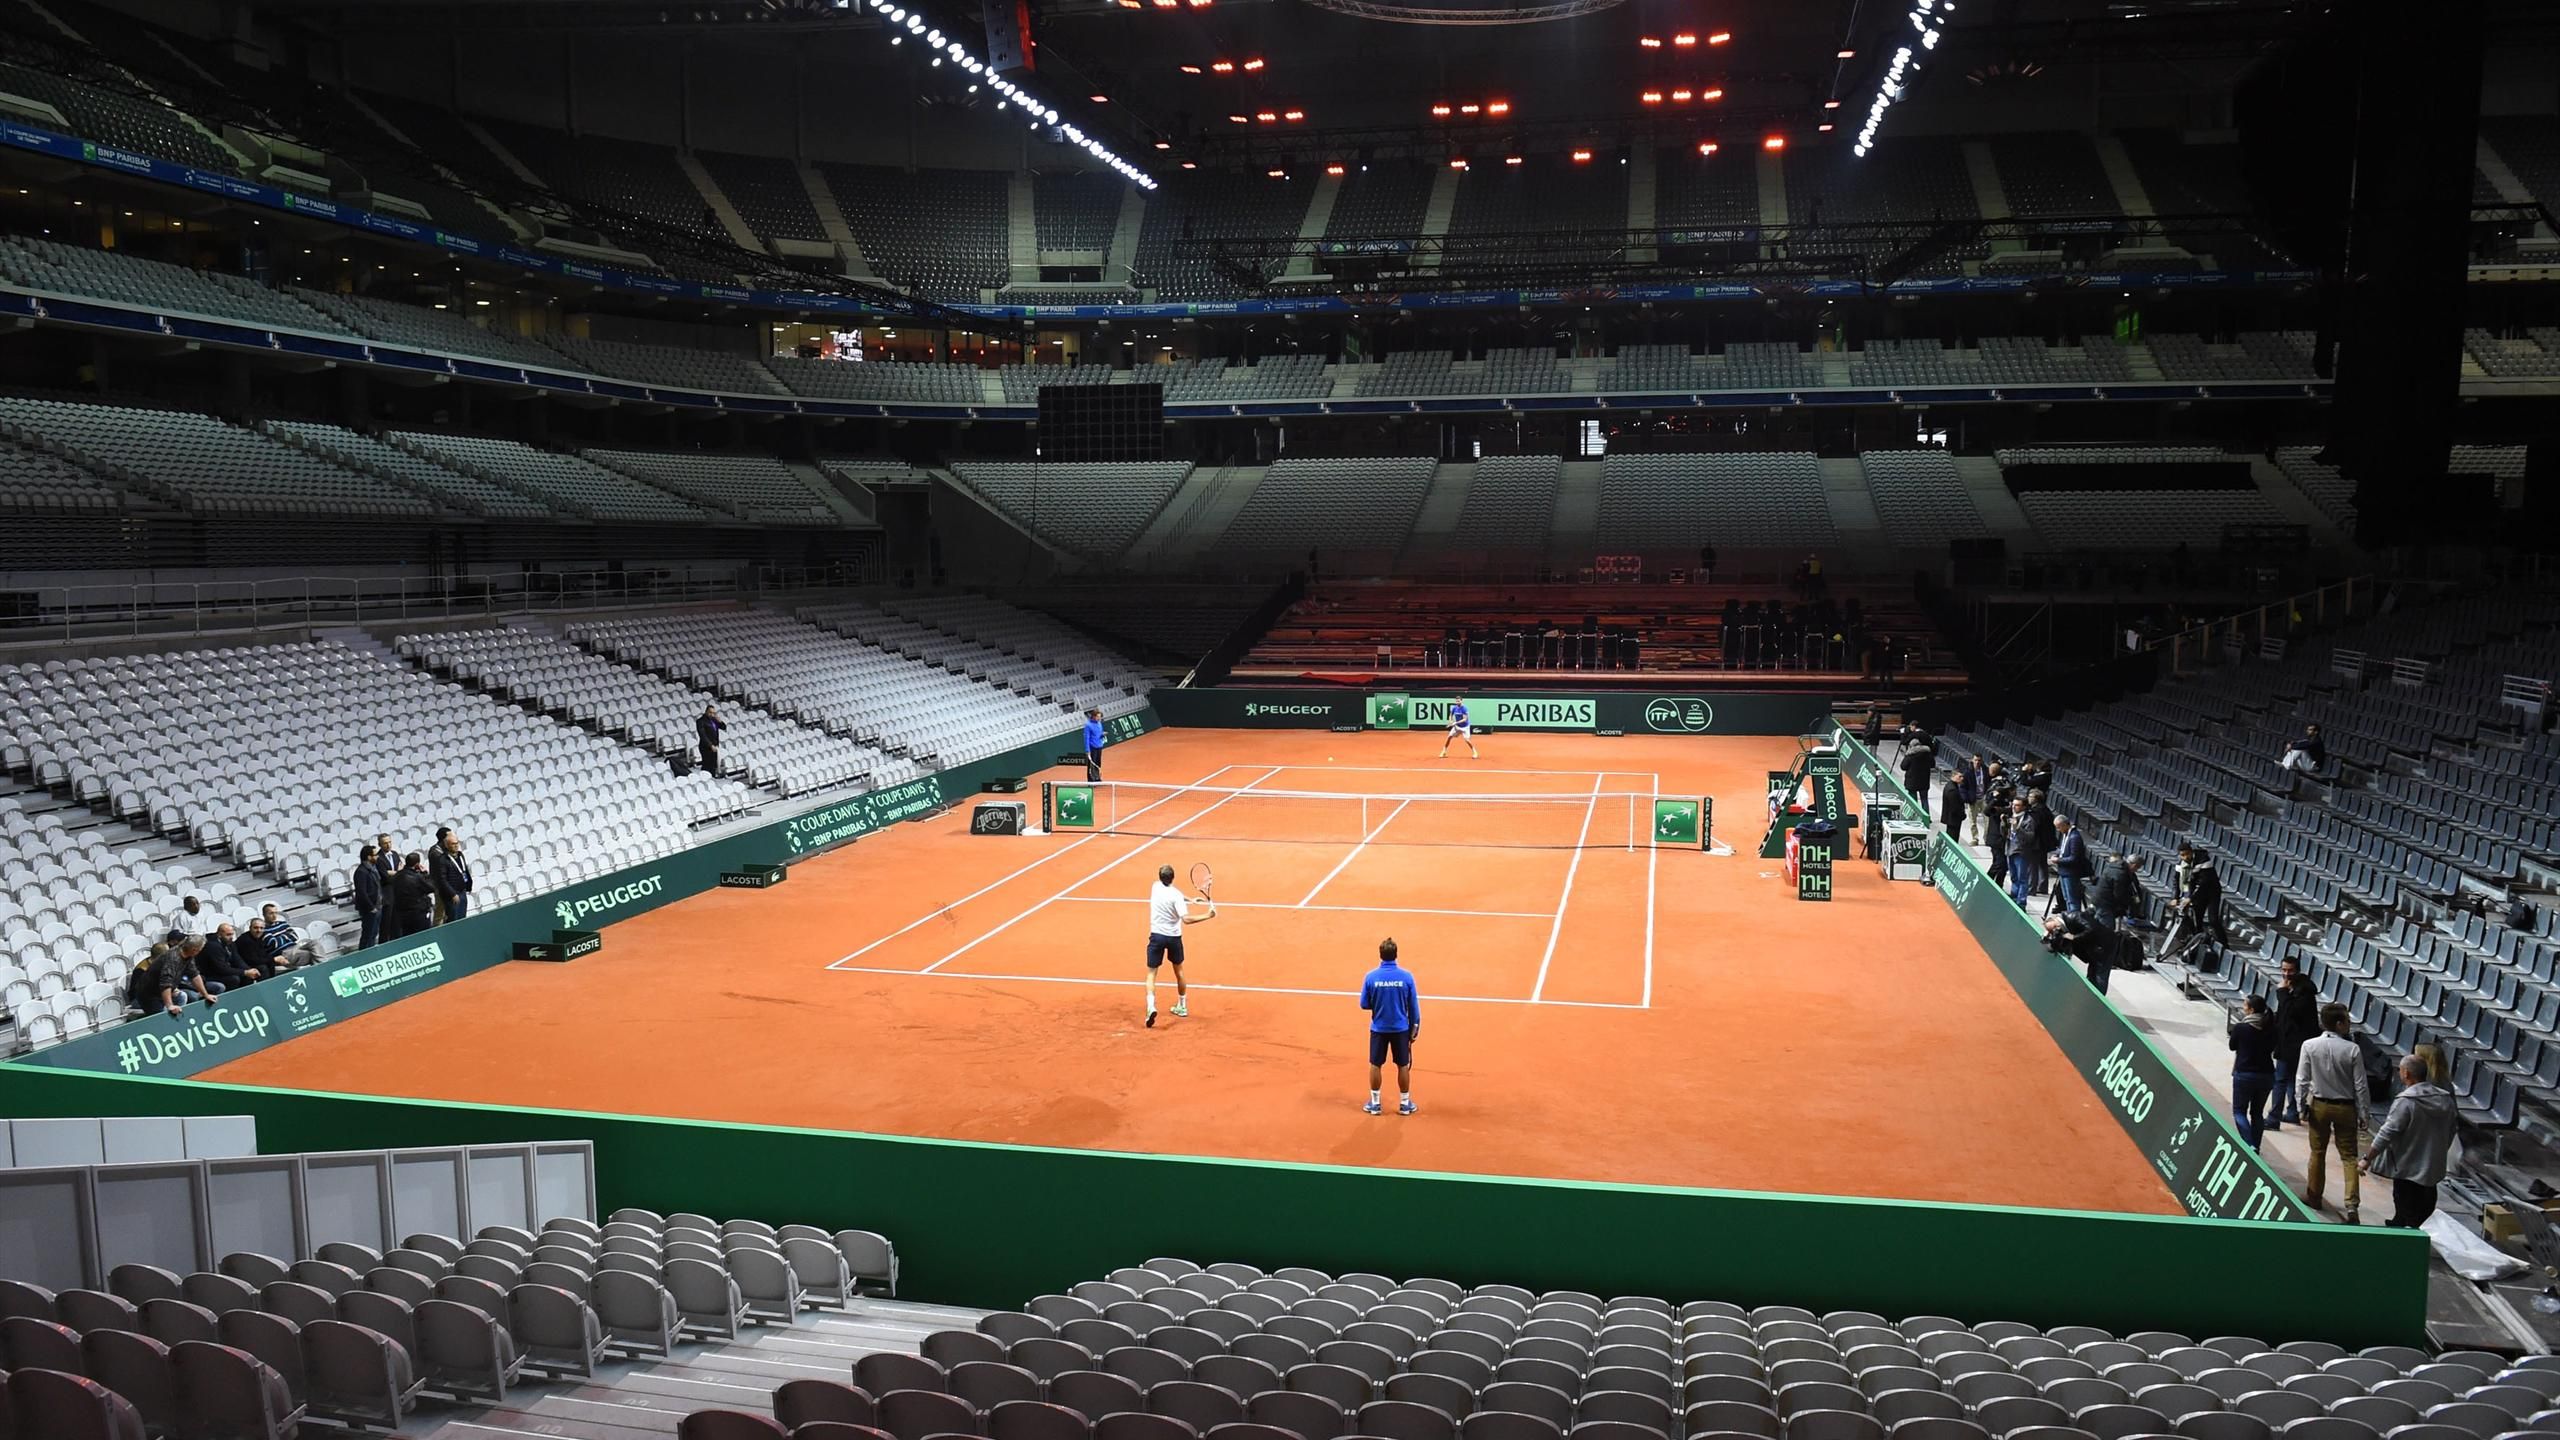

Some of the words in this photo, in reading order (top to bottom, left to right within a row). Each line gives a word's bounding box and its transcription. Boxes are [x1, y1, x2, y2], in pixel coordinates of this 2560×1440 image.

[98, 148, 115, 159] BNP
[116, 151, 151, 167] PARIBAS
[1260, 705, 1332, 714] PEUGEOT
[1498, 703, 1591, 723] PARIBAS
[1651, 712, 1669, 721] ITF
[876, 789, 903, 808] COUPE
[902, 782, 926, 800] DAVIS
[902, 797, 932, 815] PARIBAS
[1823, 776, 1838, 820] Adecco
[800, 811, 834, 832] COUPE
[834, 802, 861, 821] DAVIS
[832, 819, 867, 841] PARIBAS
[721, 875, 762, 885] LACOSTE
[575, 875, 662, 918] PEUGEOT
[566, 938, 600, 957] LACOSTE
[358, 964, 384, 983] BNP
[386, 947, 437, 975] PARIBAS
[117, 1005, 269, 1074] #DavisCup
[2096, 1042, 2154, 1123] Adecco
